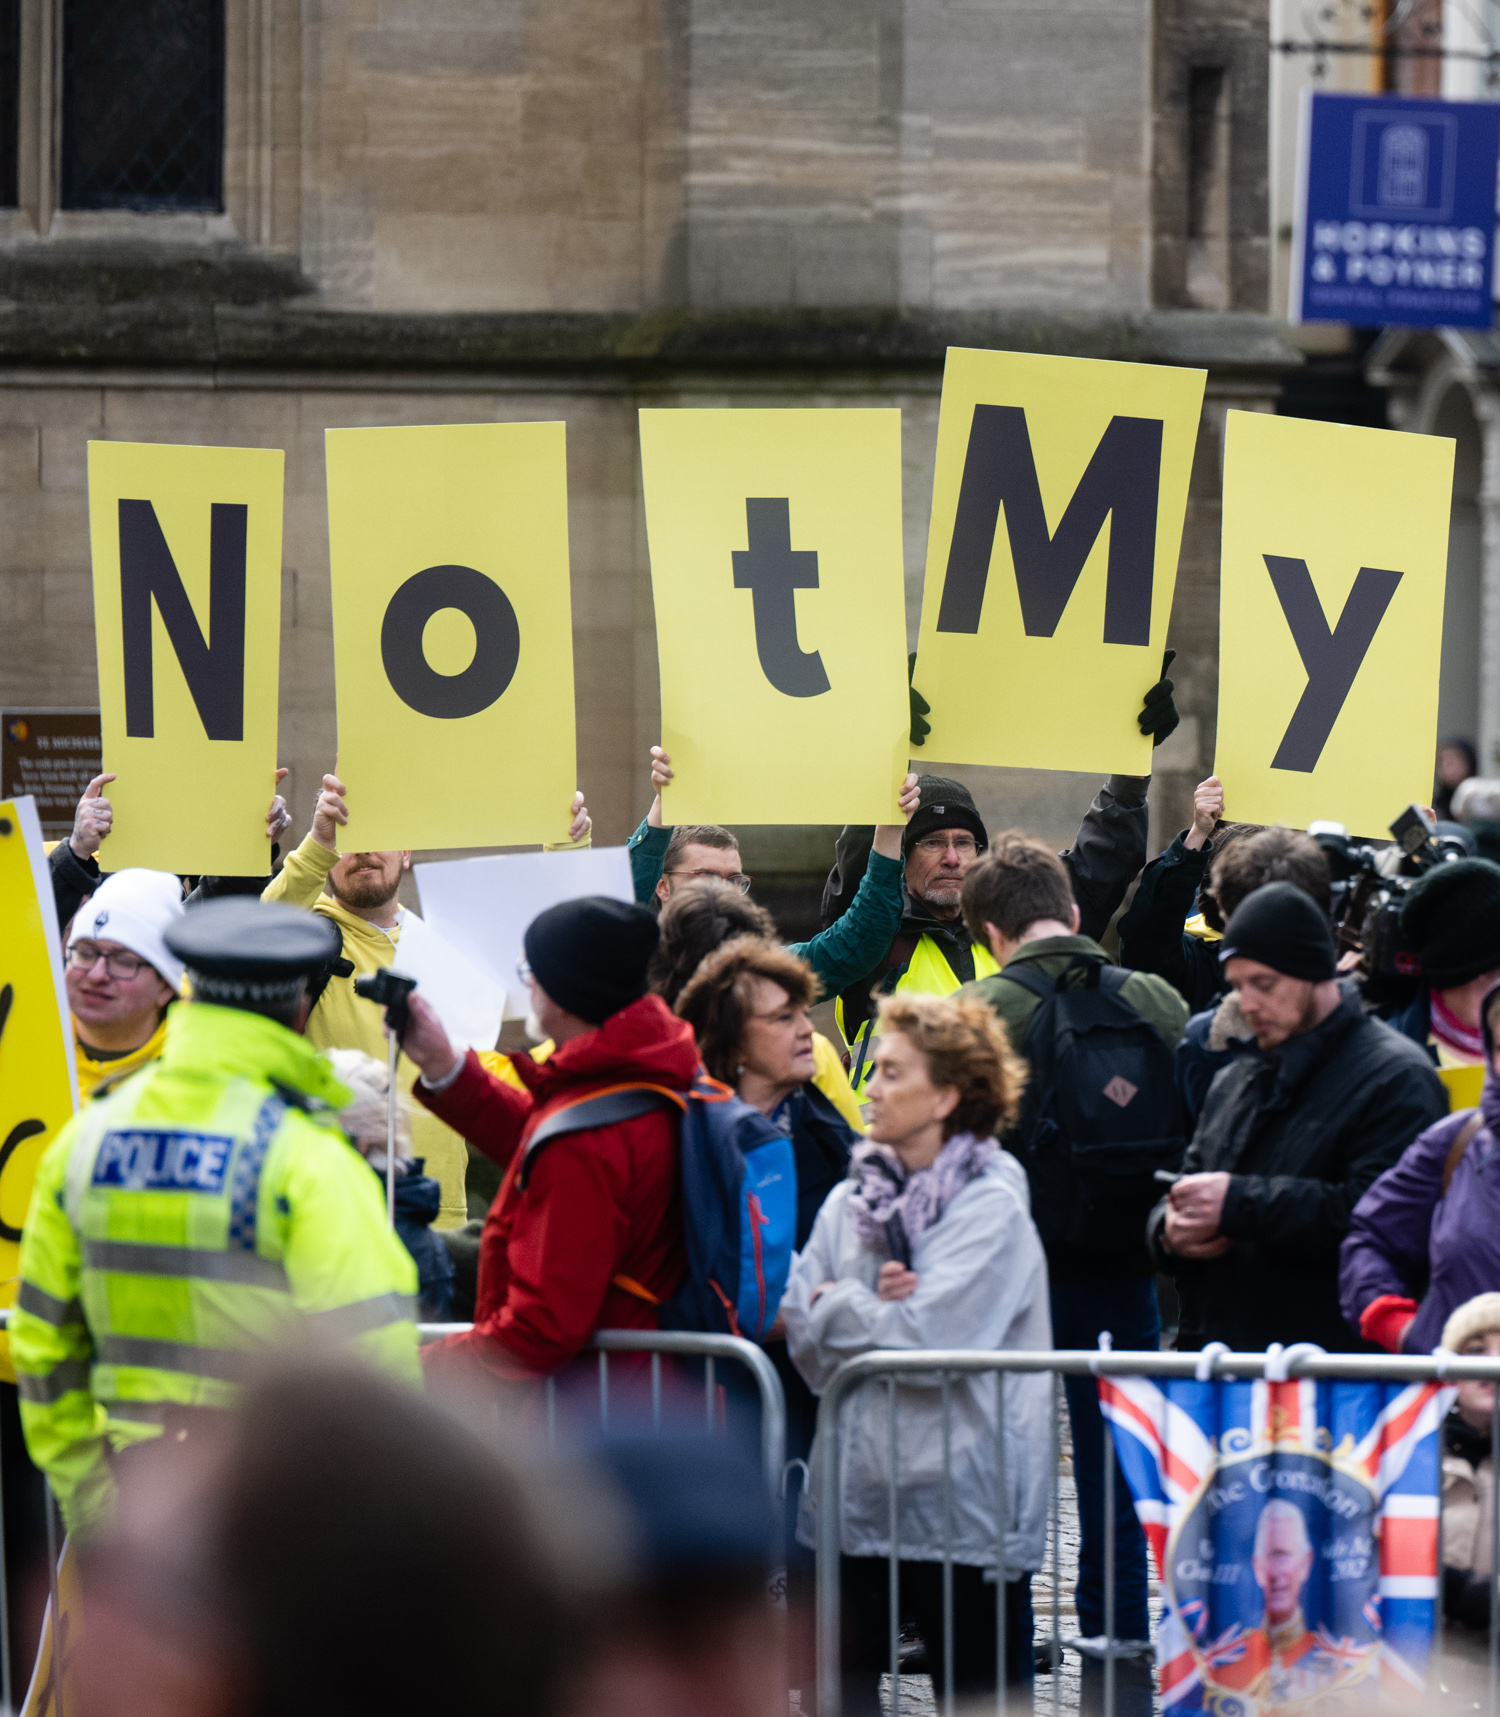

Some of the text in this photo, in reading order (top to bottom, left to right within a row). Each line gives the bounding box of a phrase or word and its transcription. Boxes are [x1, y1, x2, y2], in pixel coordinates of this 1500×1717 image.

[1313, 220, 1486, 259] HOPKINS
[1345, 254, 1484, 290] POYNER
[98, 1135, 228, 1186] POLICE
